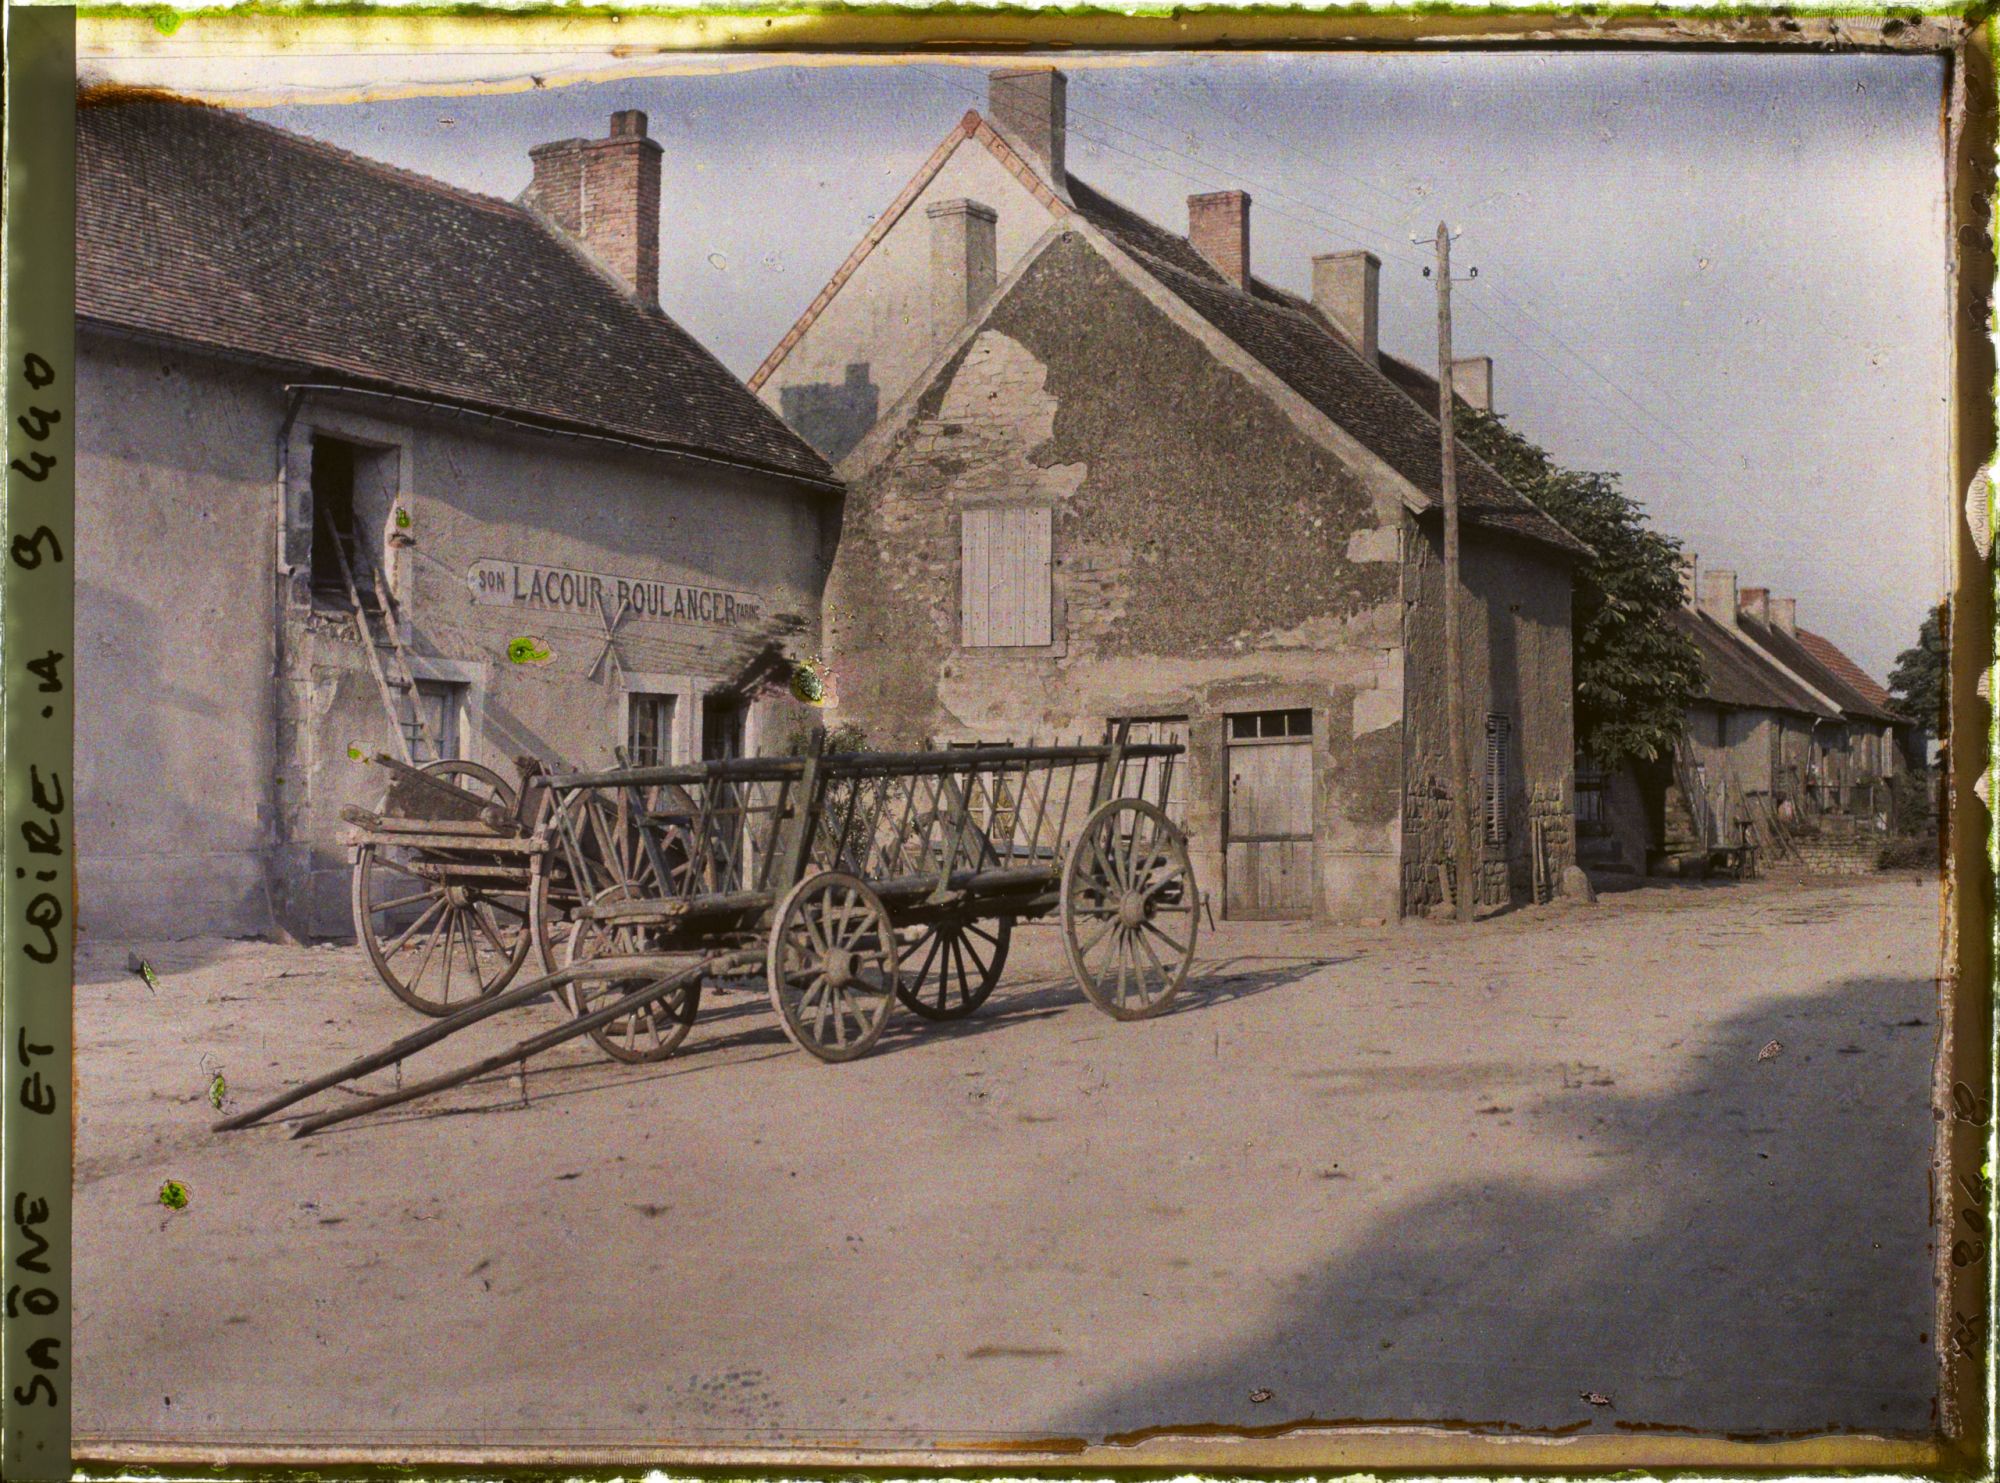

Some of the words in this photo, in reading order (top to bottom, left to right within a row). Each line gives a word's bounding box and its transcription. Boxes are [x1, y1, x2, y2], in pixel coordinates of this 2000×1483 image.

[11, 352, 62, 482] 440
[478, 569, 506, 593] SON
[512, 565, 603, 609] LACOUR
[616, 579, 738, 626] BOULANGER
[18, 1027, 56, 1115] ET
